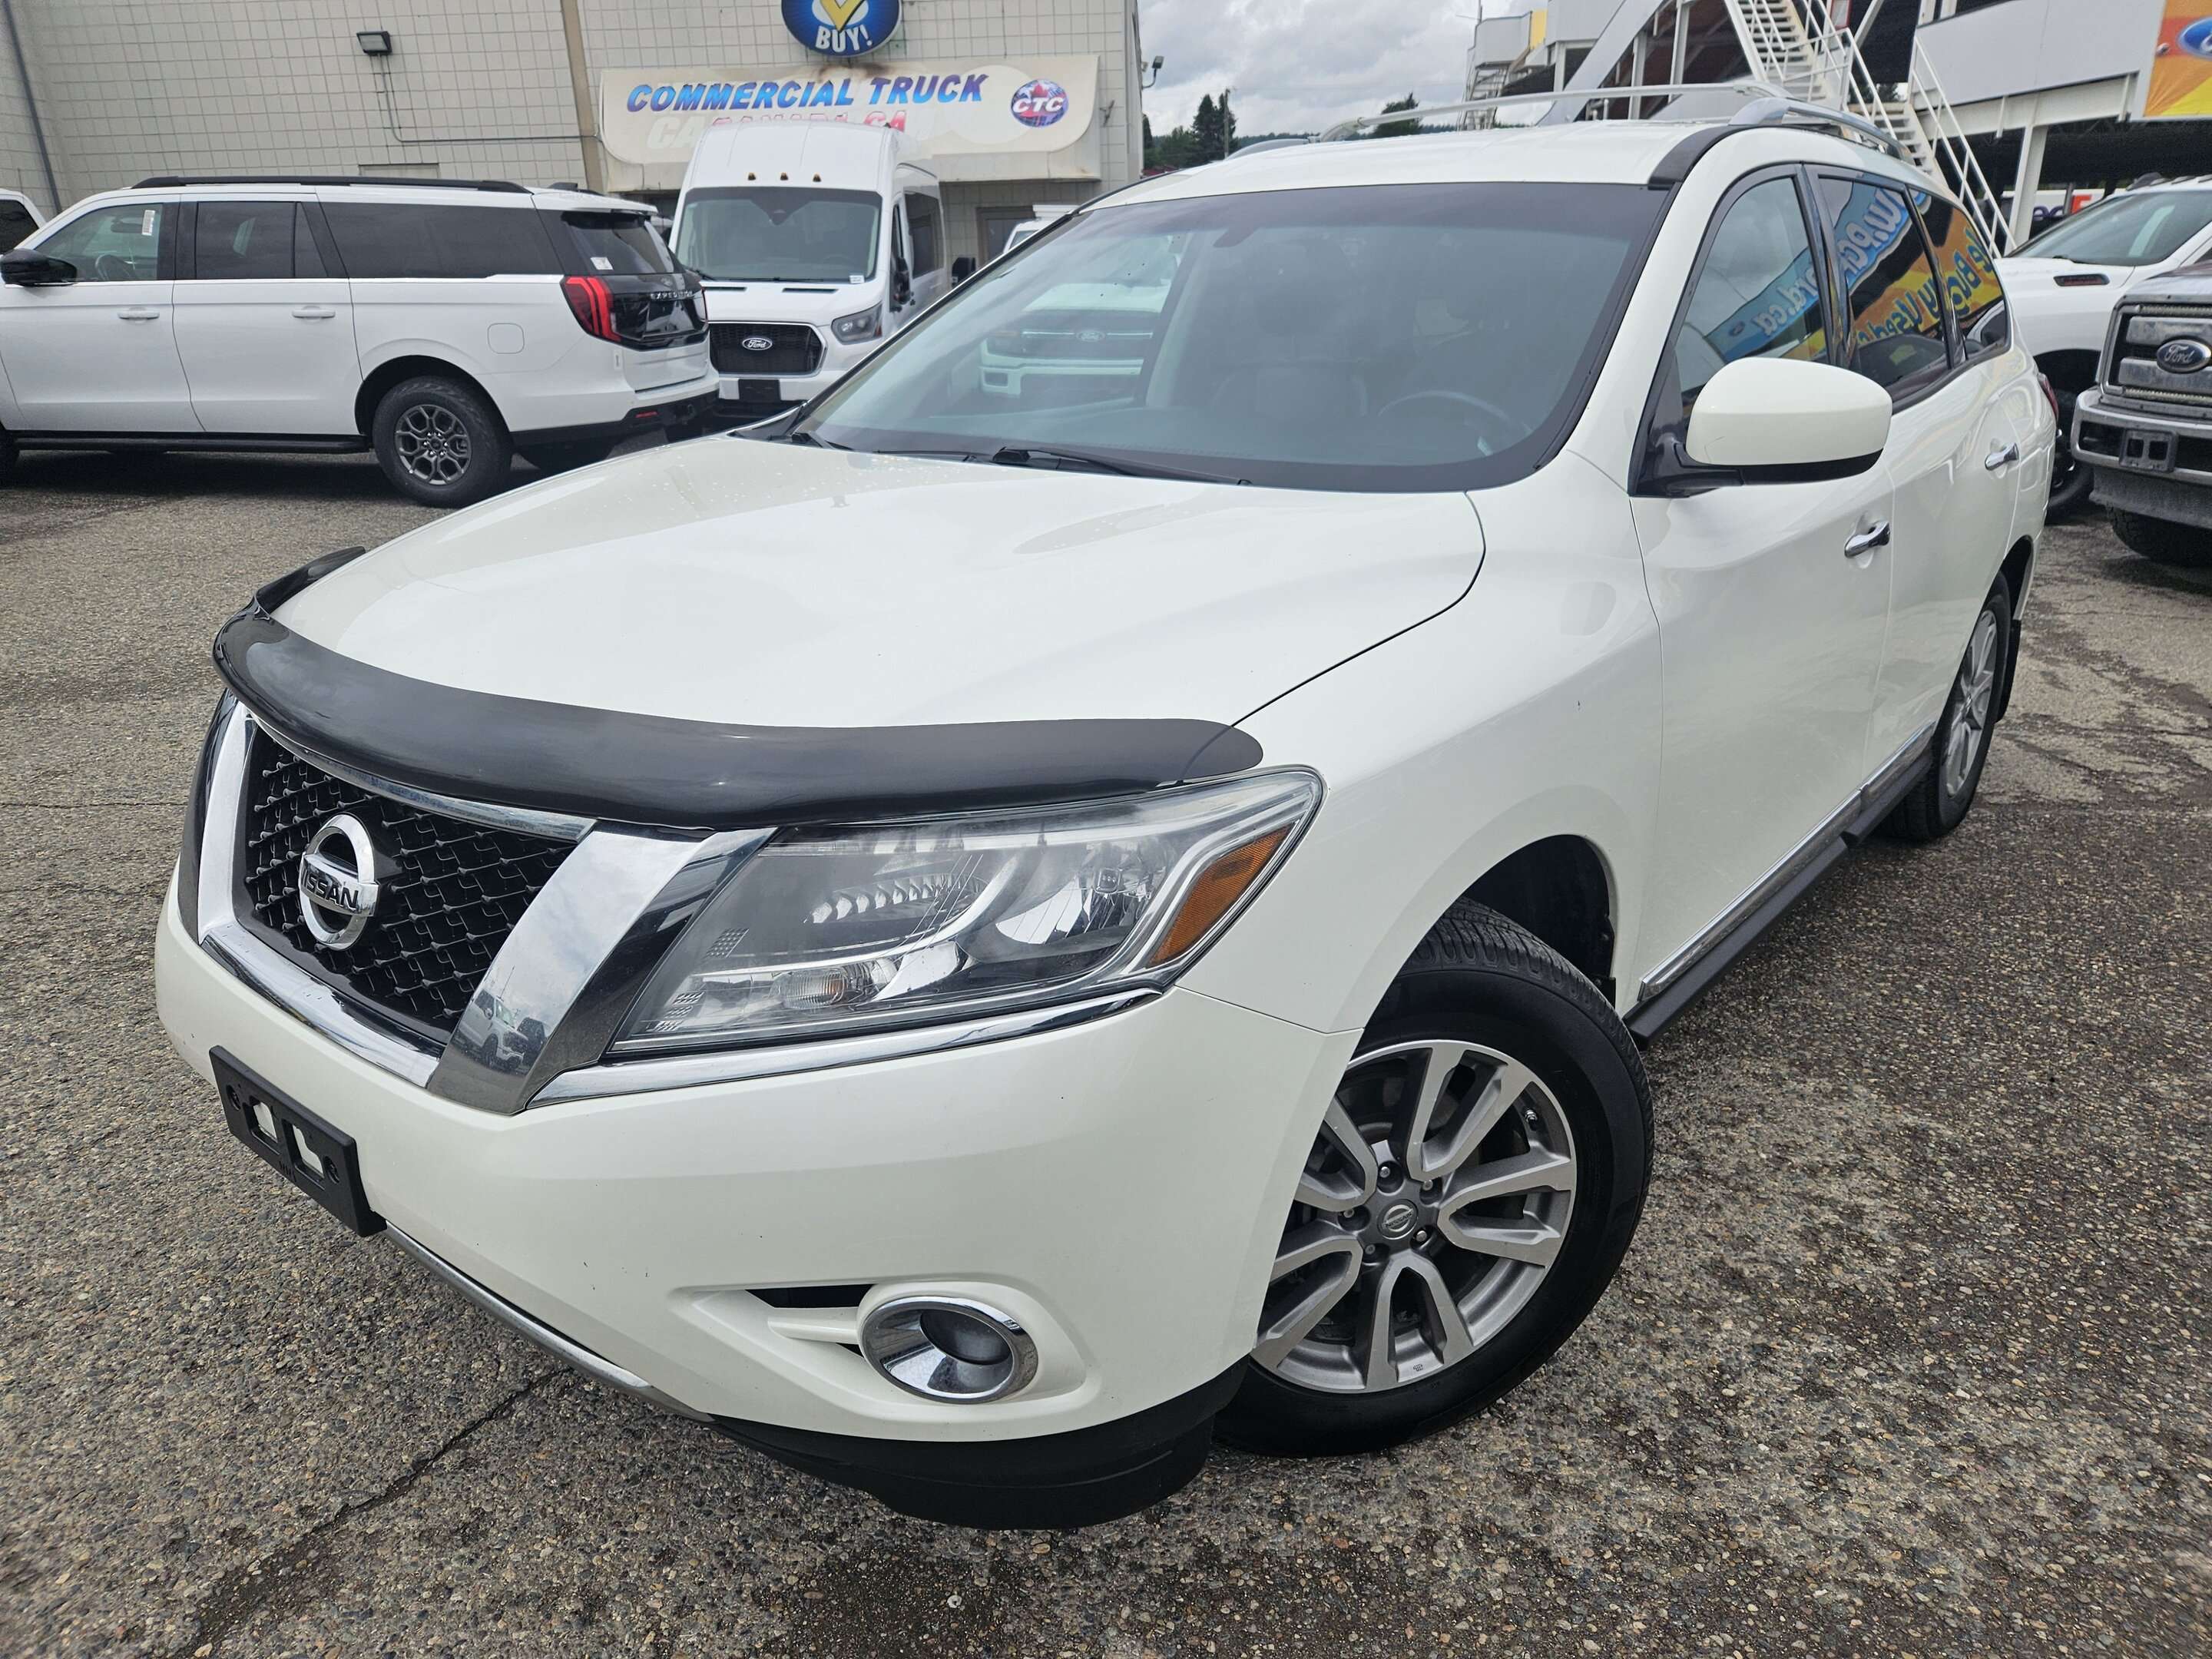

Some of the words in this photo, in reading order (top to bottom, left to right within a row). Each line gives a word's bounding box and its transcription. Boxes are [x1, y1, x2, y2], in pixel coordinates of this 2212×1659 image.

[816, 26, 873, 52] BUY!
[627, 78, 855, 112] COMMERCIAL
[869, 74, 990, 105] TRUCK
[1012, 97, 1065, 114] CTC
[2164, 344, 2195, 363] Ford
